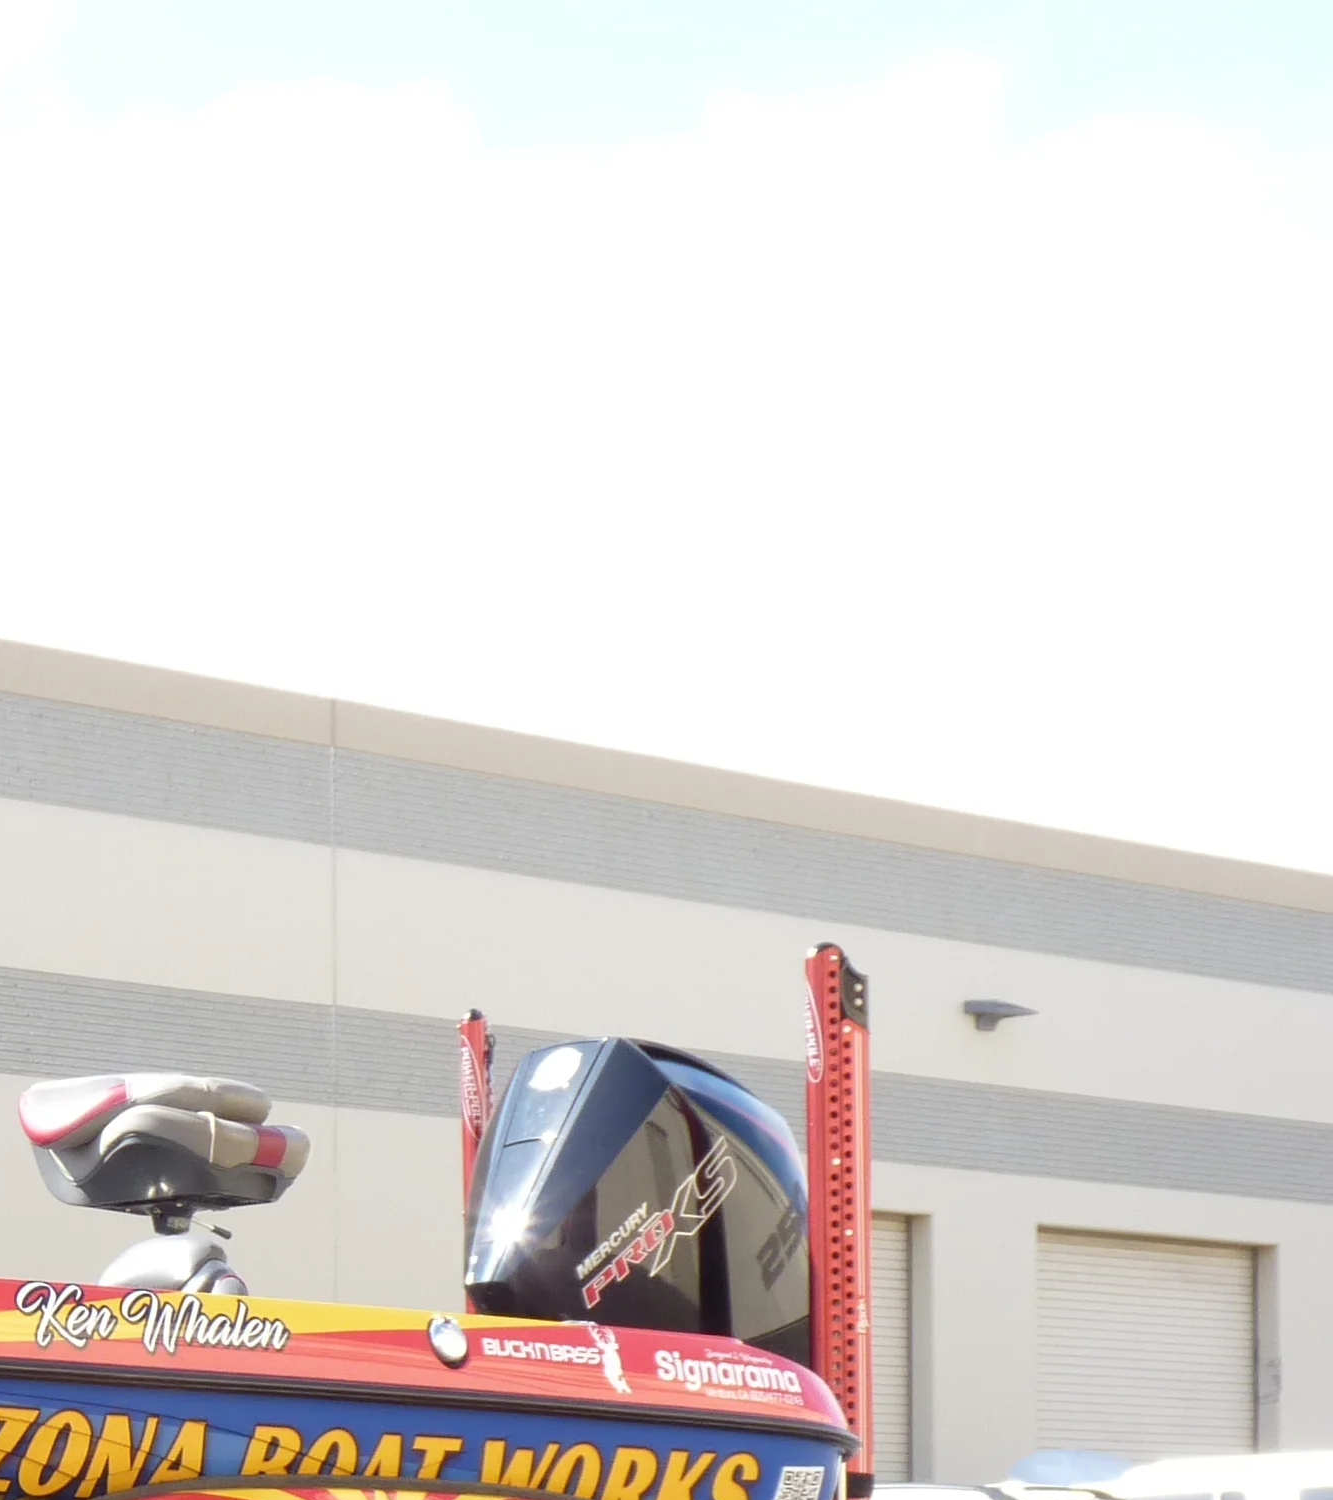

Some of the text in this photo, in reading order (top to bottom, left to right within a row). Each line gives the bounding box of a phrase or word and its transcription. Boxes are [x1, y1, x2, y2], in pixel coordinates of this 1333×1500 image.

[576, 1202, 648, 1279] MERCURY
[15, 1280, 292, 1353] Ken Whalen
[654, 1349, 803, 1393] Signarama
[241, 1424, 464, 1478] BOAT
